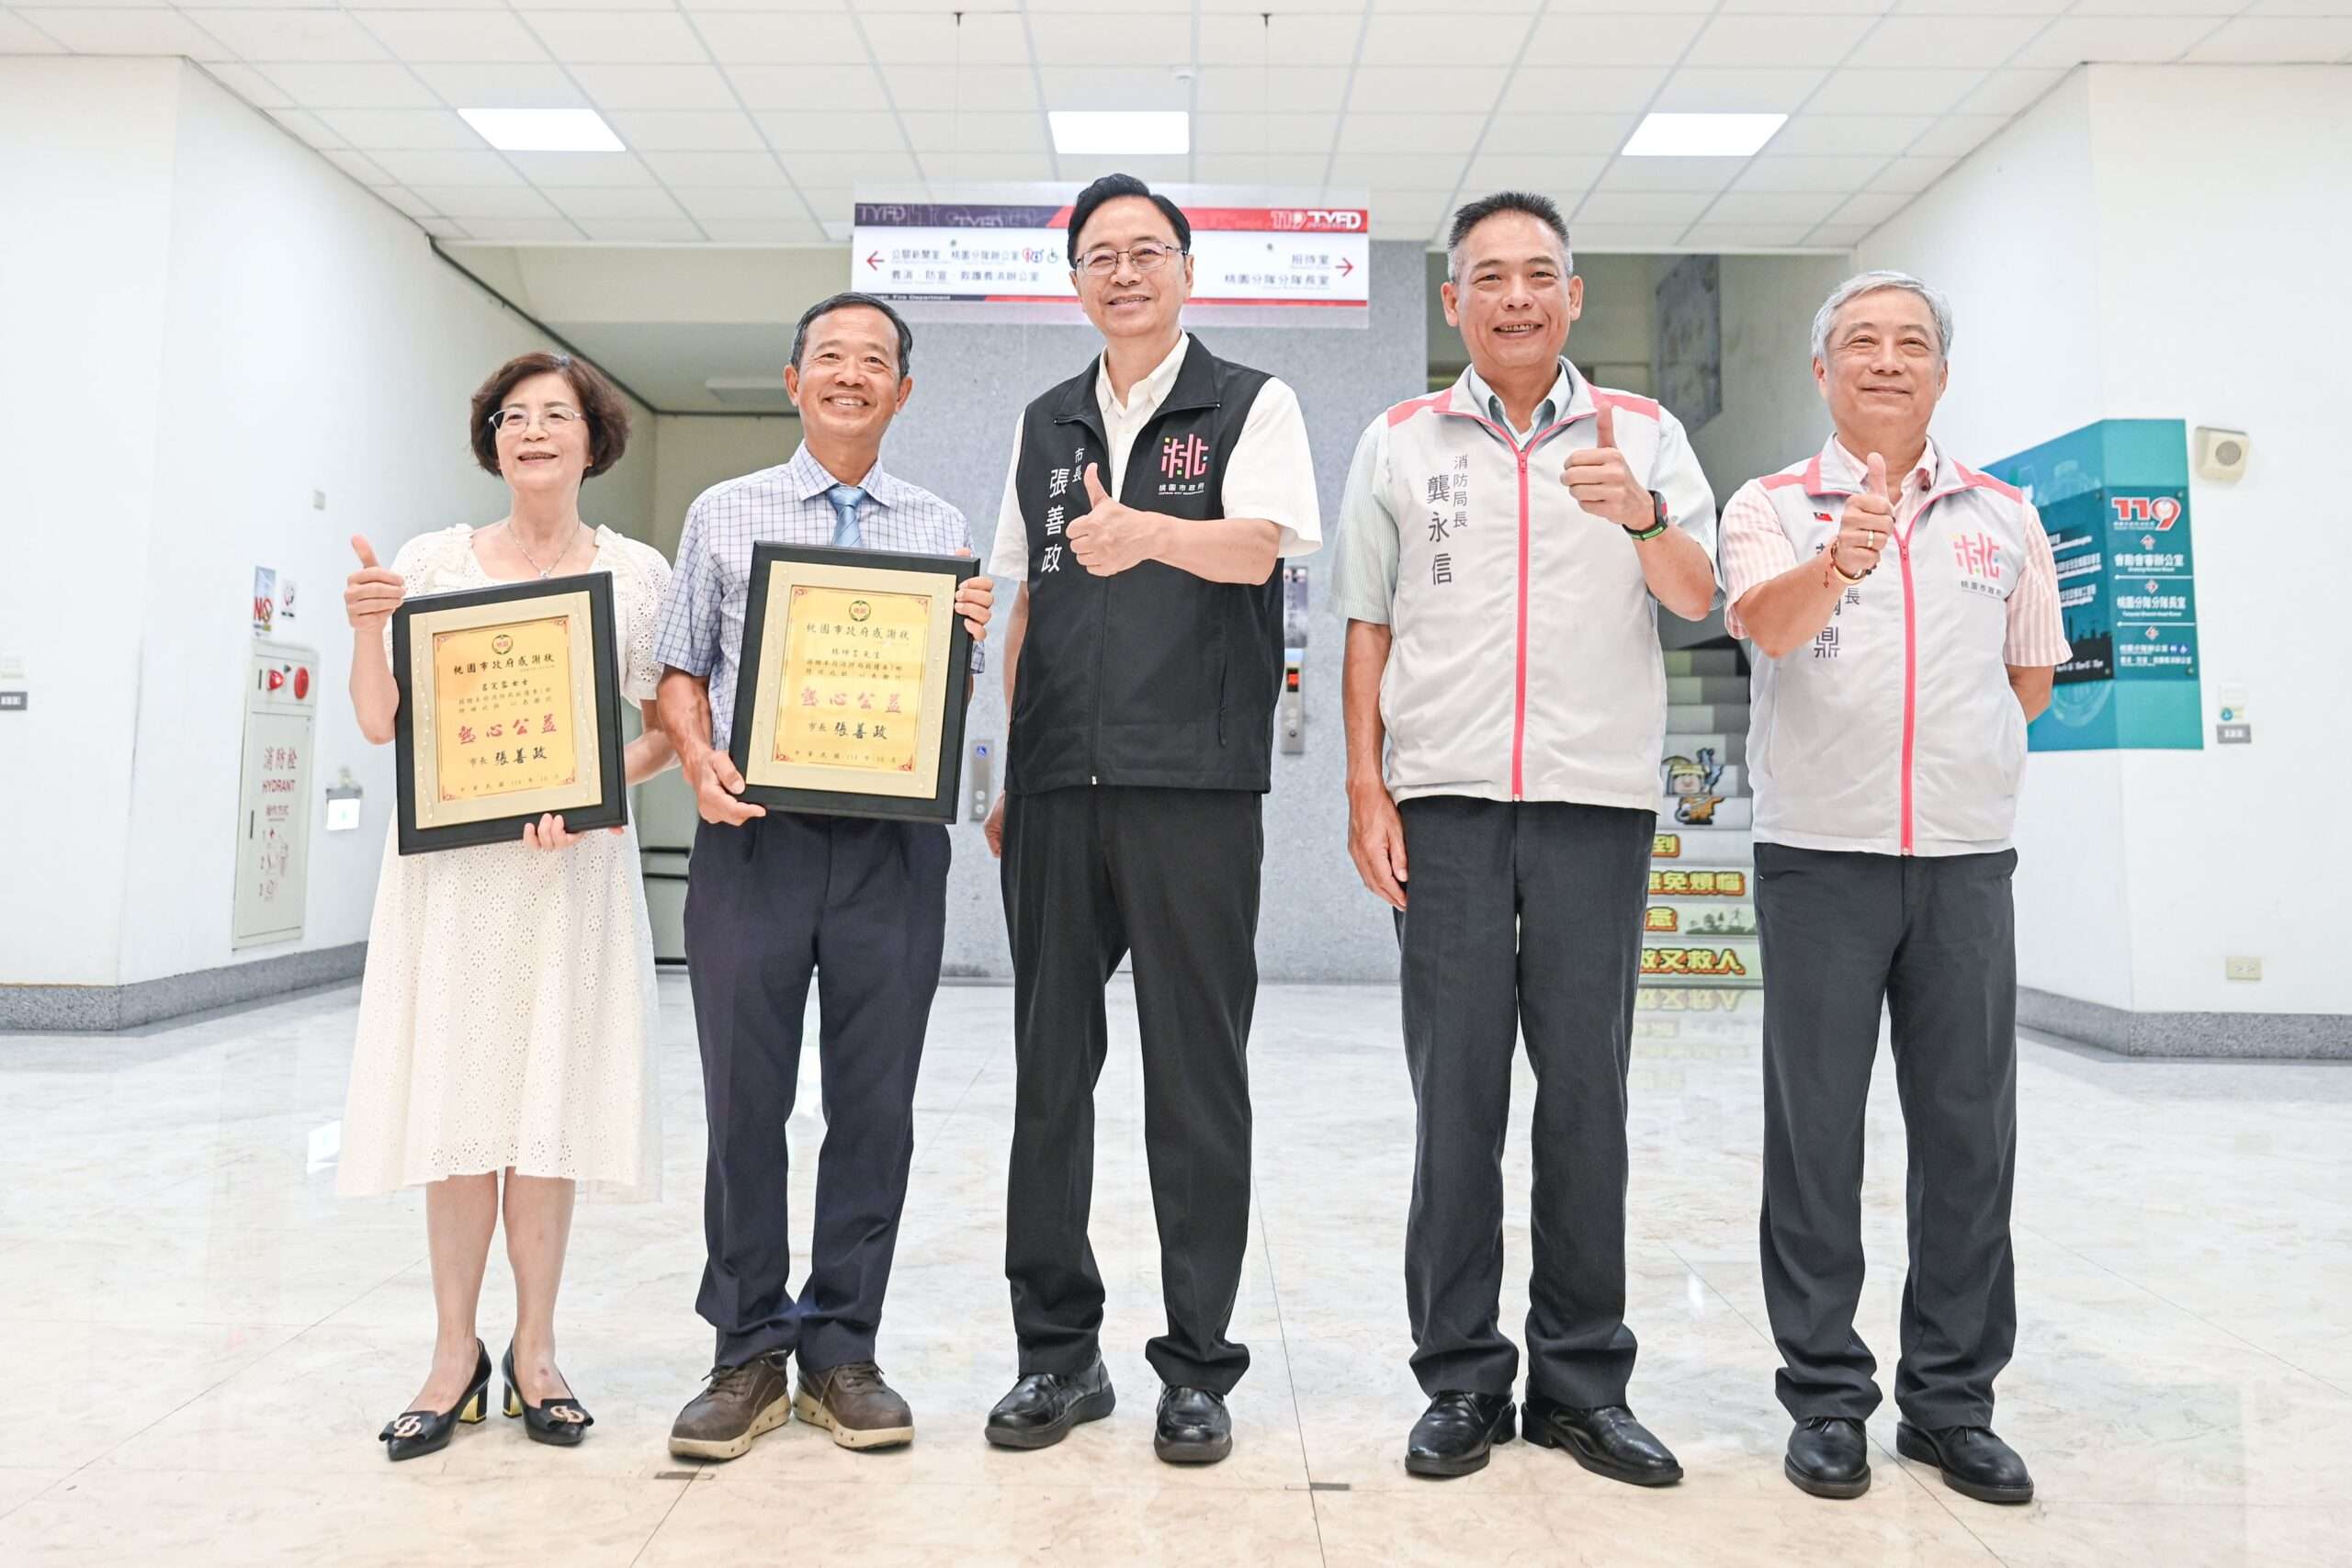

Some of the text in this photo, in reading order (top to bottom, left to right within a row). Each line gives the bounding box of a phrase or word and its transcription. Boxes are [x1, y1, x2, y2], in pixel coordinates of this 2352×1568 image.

[1306, 211, 1362, 230] TYFD
[1071, 447, 1085, 483] 市長
[1453, 455, 1468, 528] 消防局長
[1041, 468, 1070, 574] 張善政
[2111, 496, 2181, 531] 119
[1427, 474, 1453, 585] 龔永信
[807, 623, 910, 640] 桃園市政府感謝狀
[454, 653, 555, 675] 桃園市政府感謝狀
[835, 721, 888, 739] 張善政
[496, 745, 548, 766] 張善政
[262, 779, 296, 794] HYDRANT
